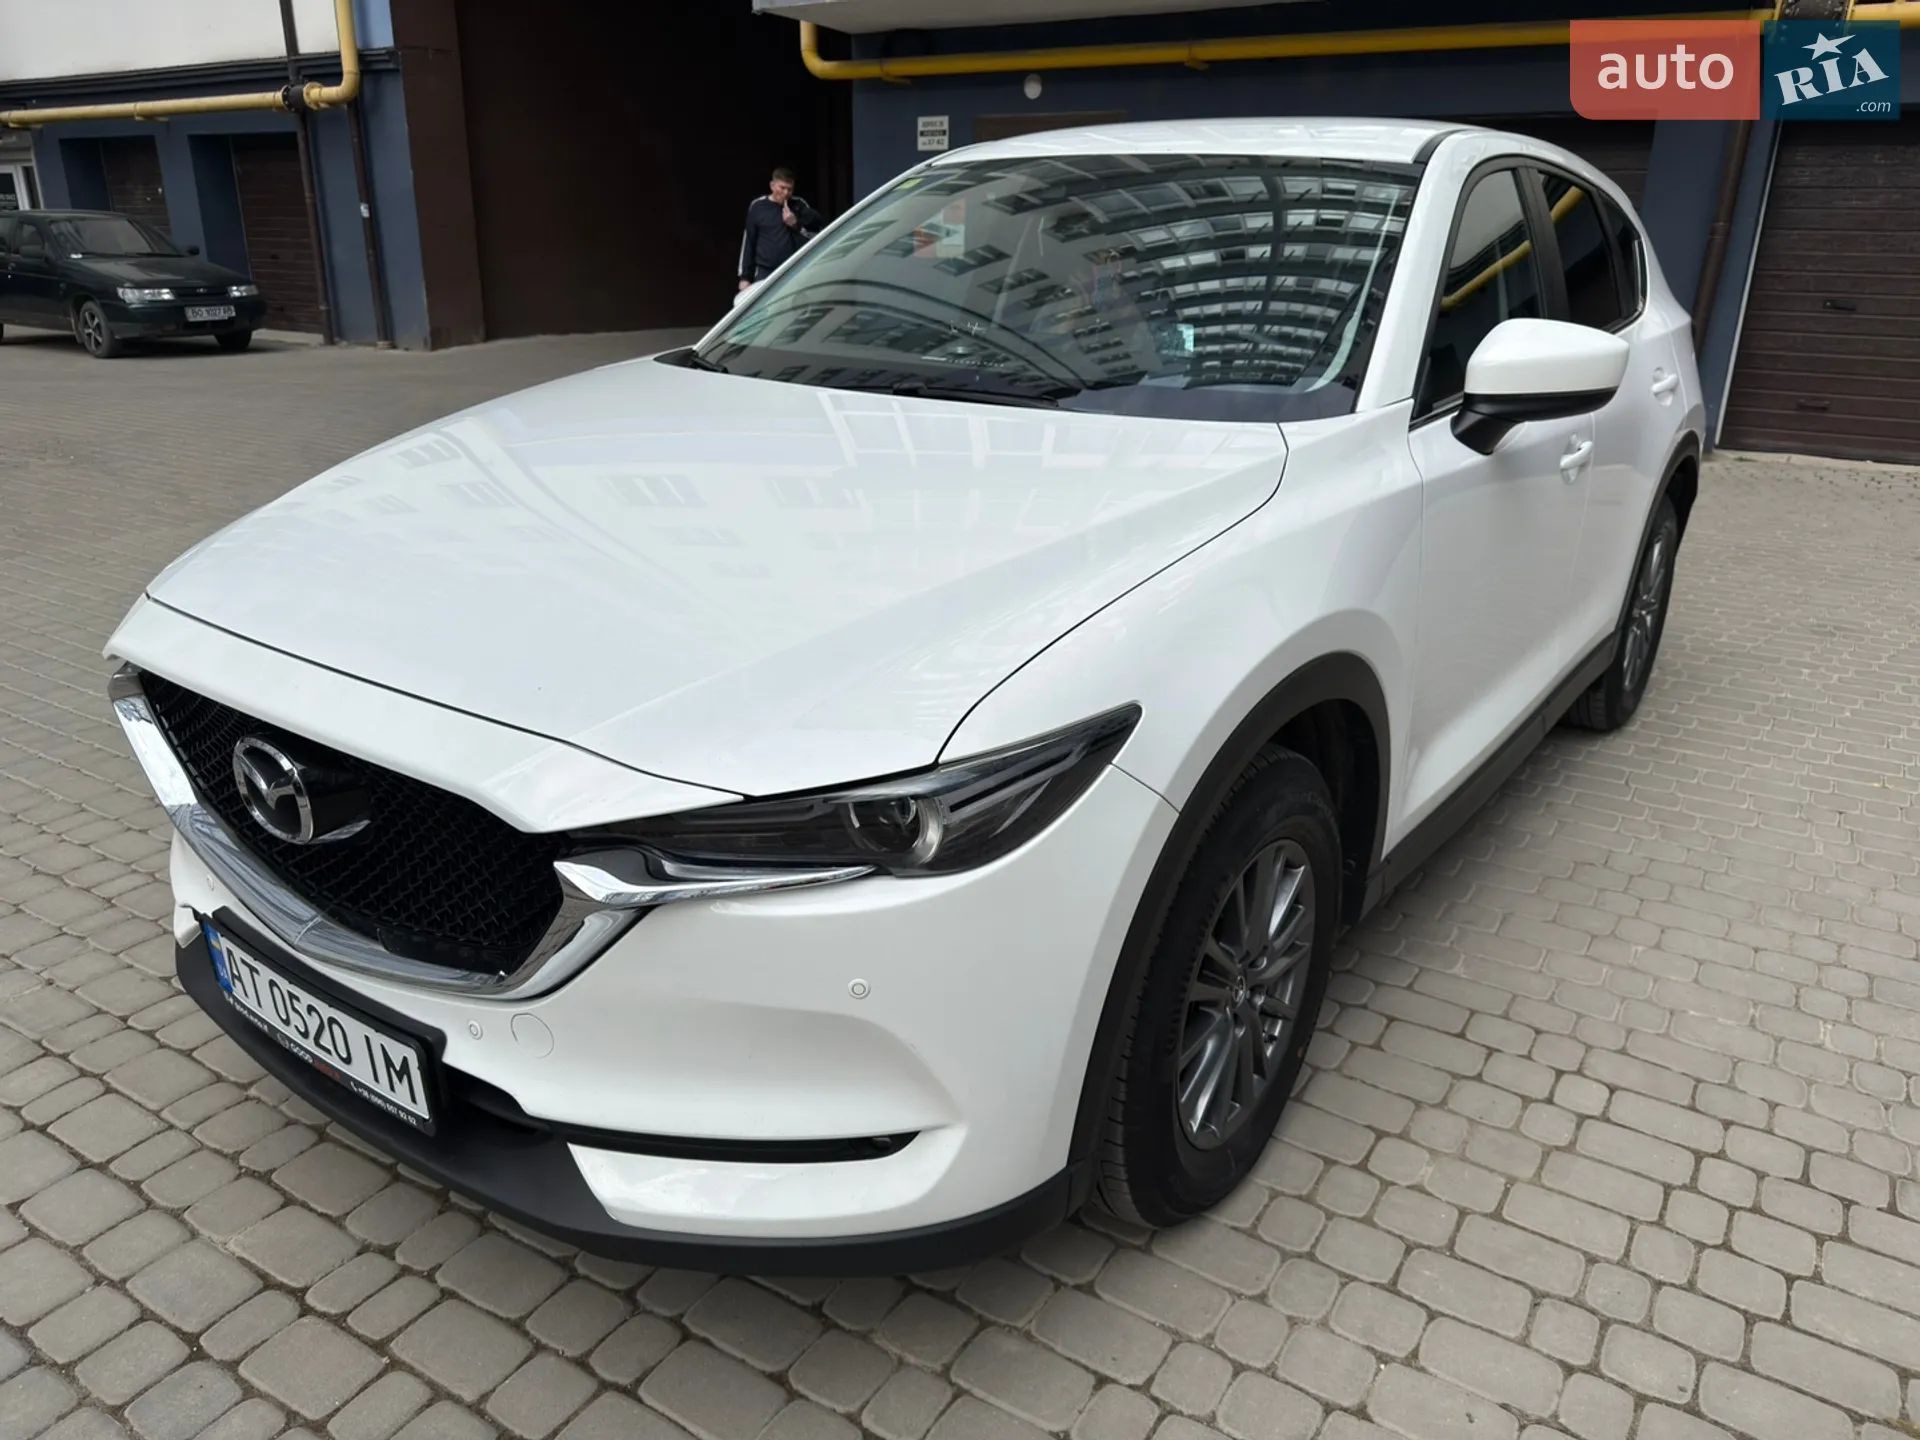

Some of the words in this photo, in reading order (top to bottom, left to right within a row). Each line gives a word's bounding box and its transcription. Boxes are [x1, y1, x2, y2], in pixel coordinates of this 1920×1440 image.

[226, 947, 263, 1009] AT
[268, 978, 352, 1066] 0520
[364, 1033, 418, 1106] IM
